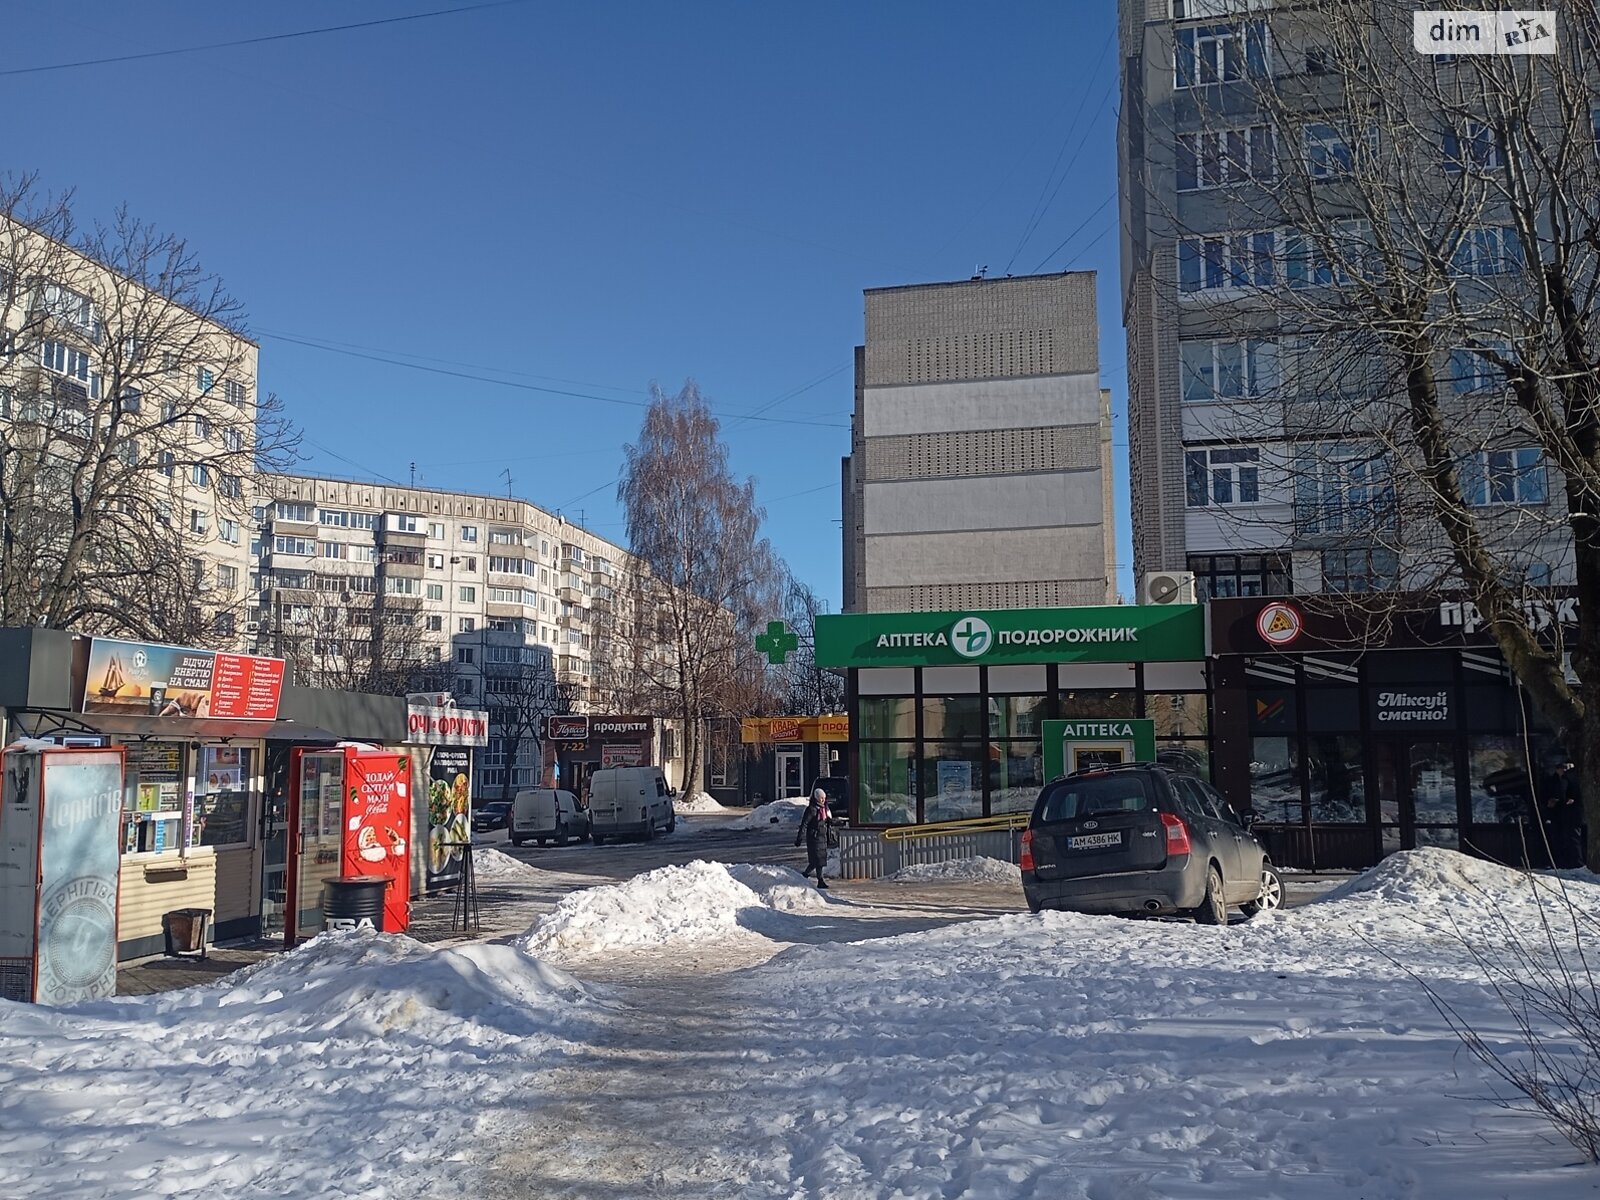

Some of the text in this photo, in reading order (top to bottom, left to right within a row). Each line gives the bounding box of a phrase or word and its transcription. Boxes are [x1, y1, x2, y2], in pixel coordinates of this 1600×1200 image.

[876, 626, 1138, 648] АПТЕКА ПОДОРОЖНИК
[182, 658, 214, 669] ВІДЧУЙ
[173, 667, 211, 678] ЕНЕРГІЮ
[168, 677, 209, 688] НА СМАК!
[1377, 691, 1447, 709] Міксуй
[1378, 706, 1448, 721] смачно!
[438, 715, 485, 736] ФРУКТИ
[593, 722, 647, 733] продукти
[1063, 723, 1134, 736] АПТЕКА
[561, 742, 585, 751] 7-22
[365, 771, 394, 782] ДОДАЙ
[1073, 833, 1120, 846] AM 4386 HK
